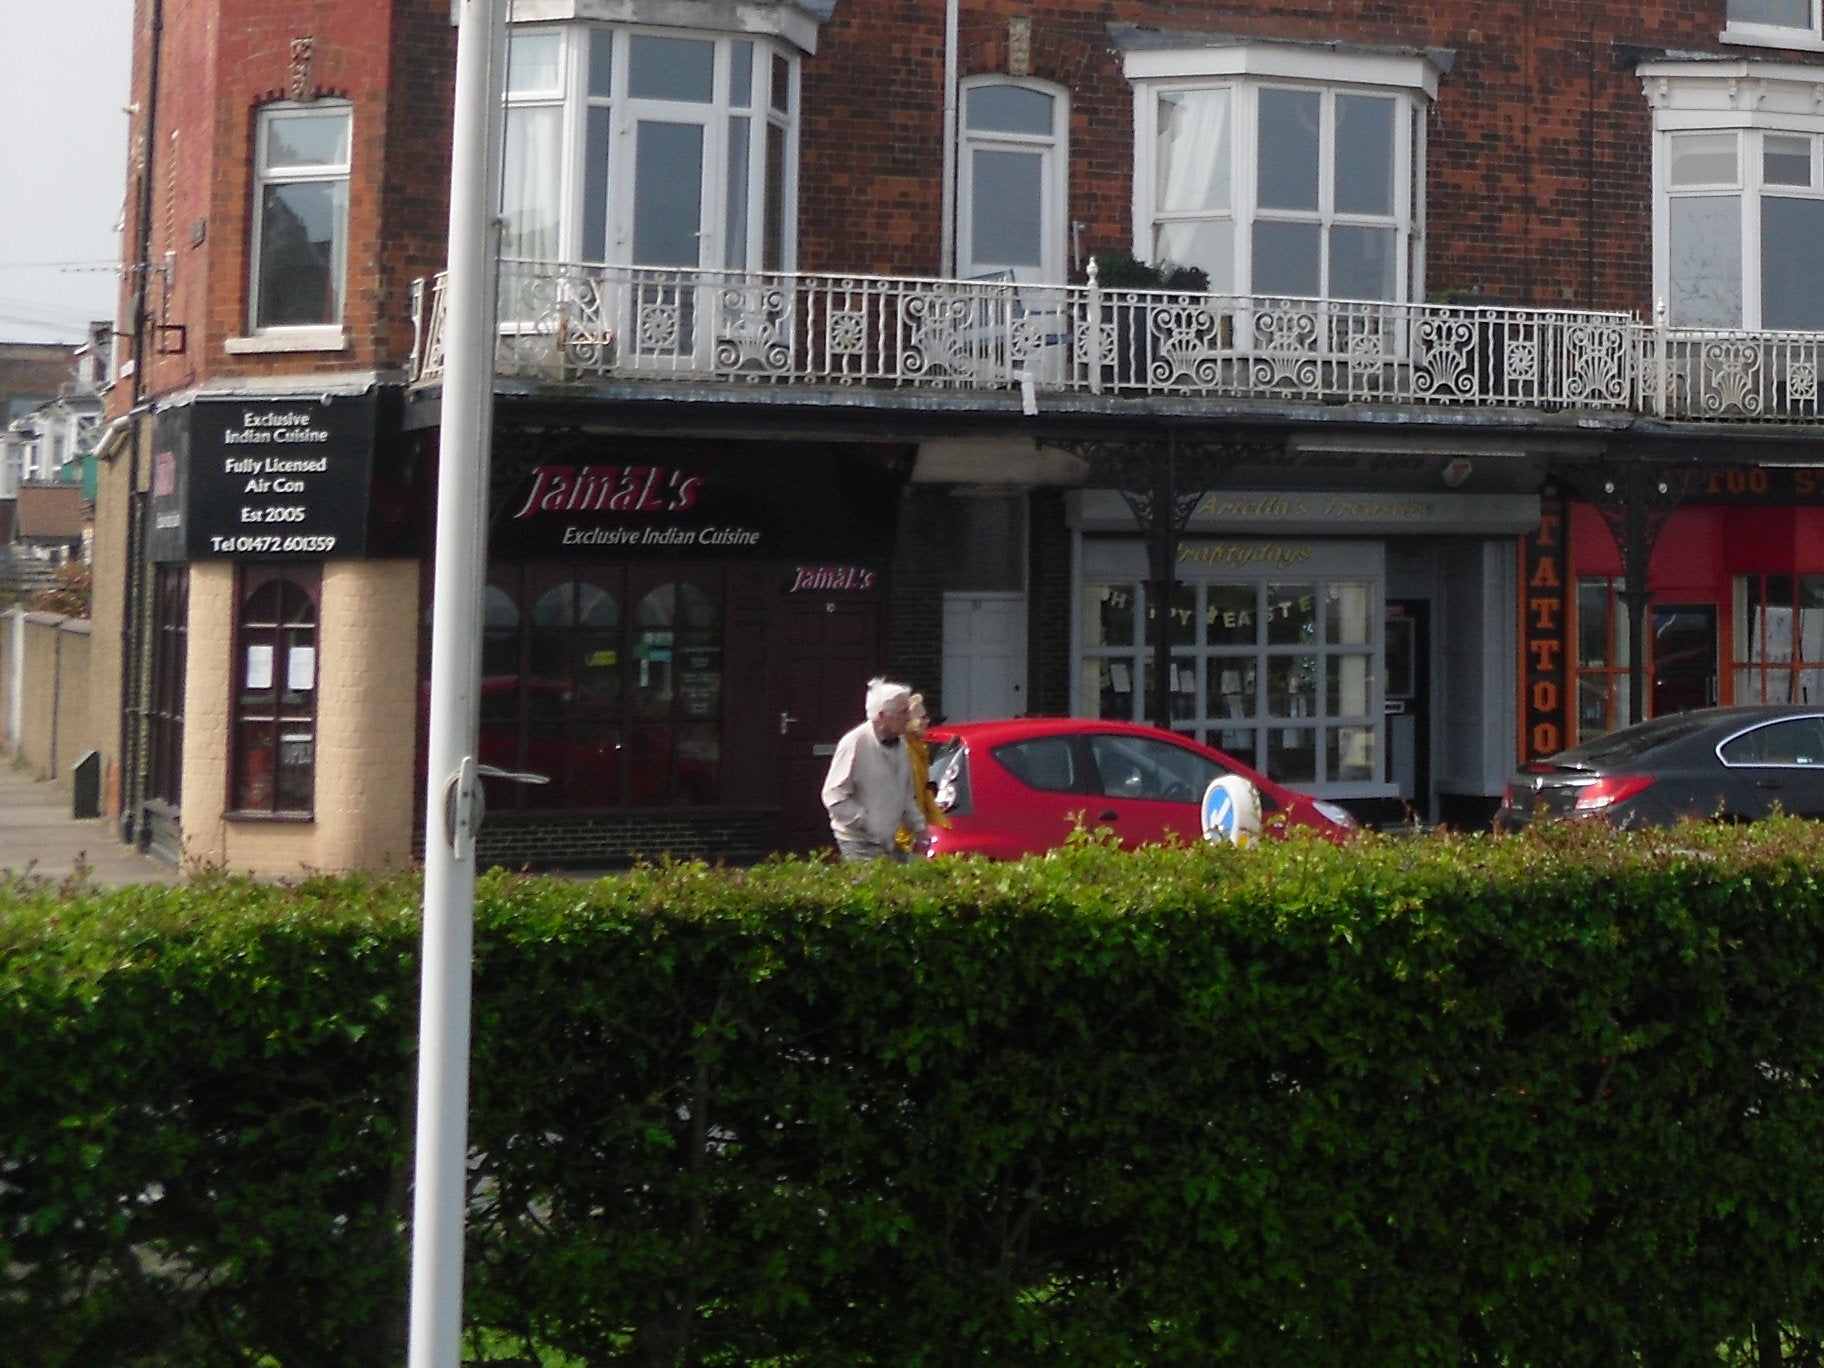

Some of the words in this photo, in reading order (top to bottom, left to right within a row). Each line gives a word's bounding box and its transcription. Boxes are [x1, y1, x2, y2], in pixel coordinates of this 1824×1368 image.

[243, 412, 311, 428] Exclusive
[224, 429, 271, 445] Indian
[273, 428, 329, 444] Cuisine
[224, 458, 262, 475] Fully
[264, 457, 328, 473] Licensed
[244, 479, 271, 493] Air
[272, 478, 305, 493] Con
[240, 507, 263, 523] Est
[264, 506, 307, 523] 2005
[210, 536, 235, 552] Tel
[236, 536, 282, 552] 01472
[283, 536, 337, 553] 601359
[562, 527, 640, 545] Exclusive
[641, 527, 695, 545] Indian
[698, 527, 761, 545] Cuisine
[1530, 514, 1561, 754] TATTOO
